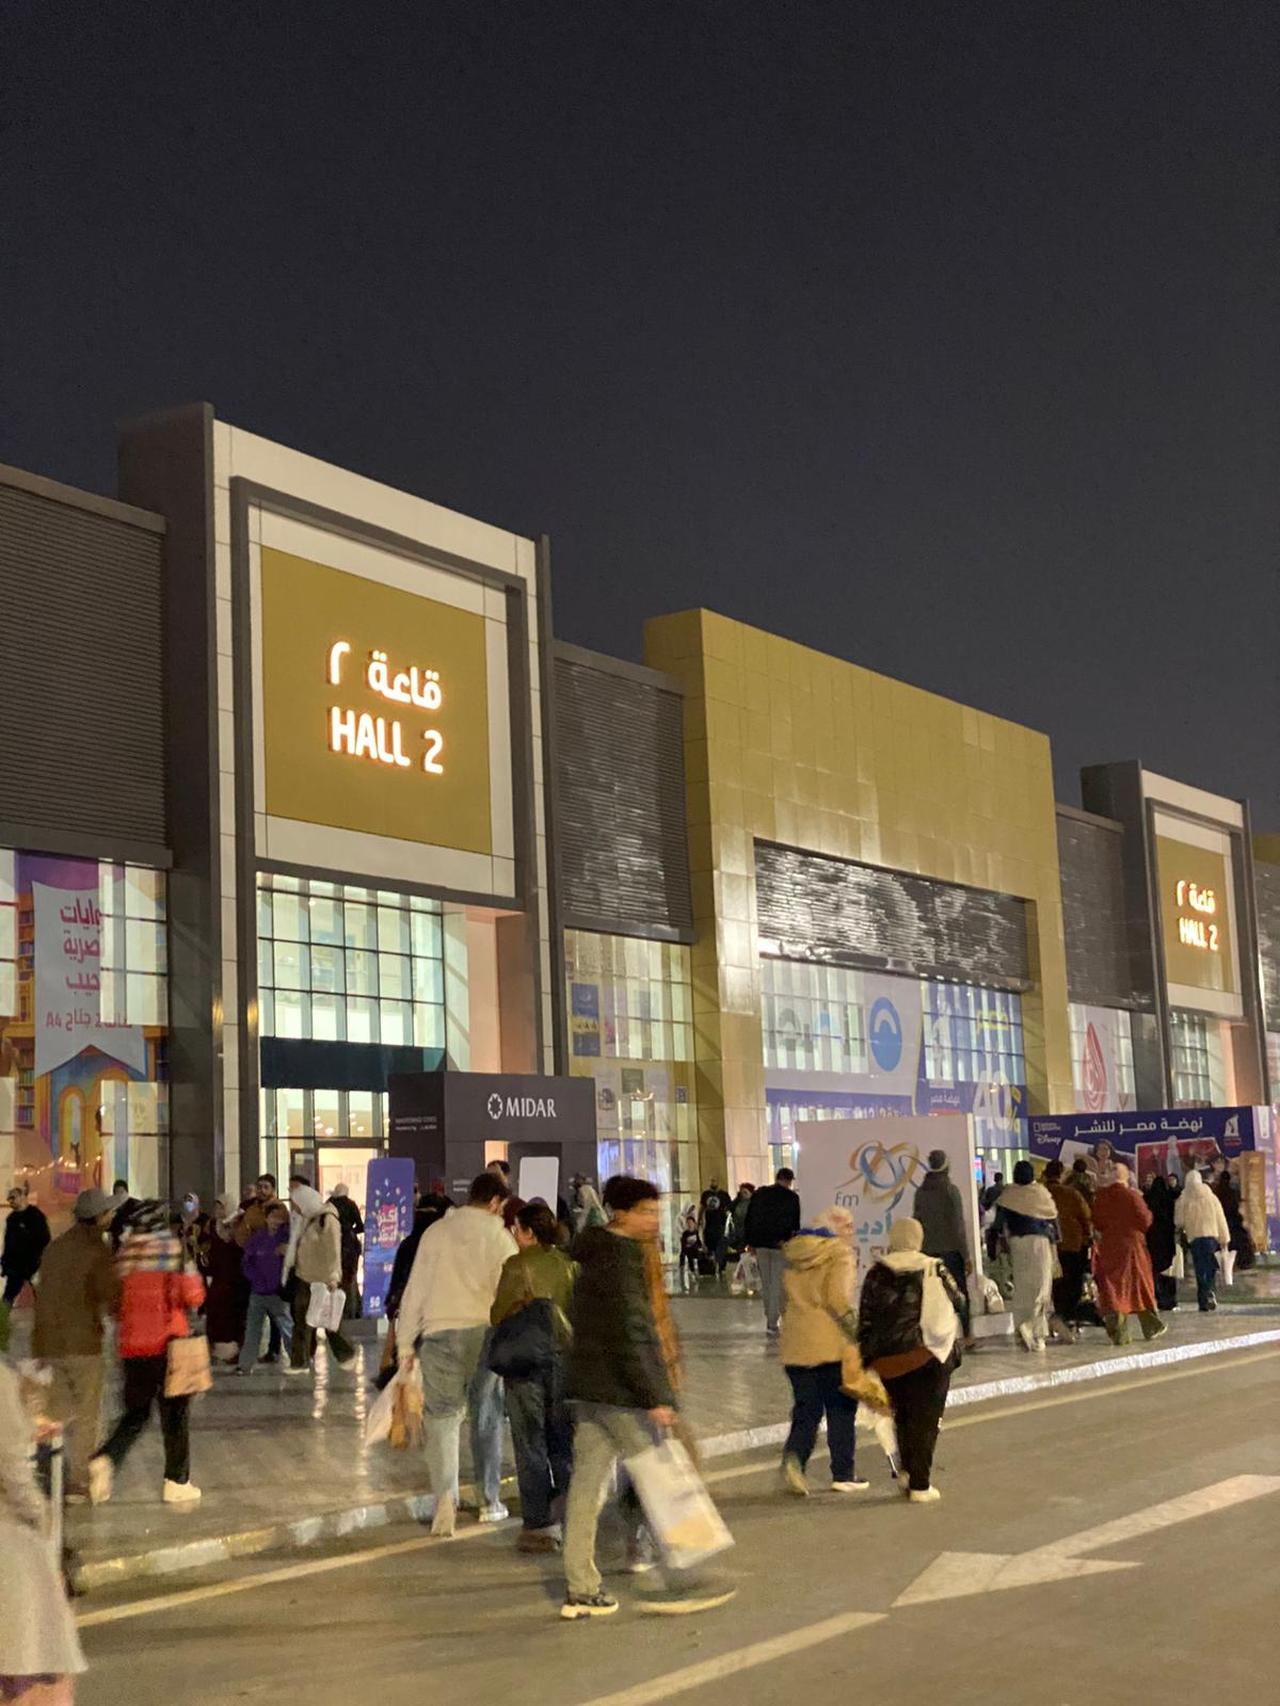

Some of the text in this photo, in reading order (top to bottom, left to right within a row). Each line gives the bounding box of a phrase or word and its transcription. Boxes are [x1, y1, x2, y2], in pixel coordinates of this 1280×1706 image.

[367, 649, 442, 711] قاعة
[331, 705, 444, 775] HALL 2
[59, 898, 104, 934] وايات
[63, 929, 101, 964] صرية
[1179, 917, 1219, 952] HALL 2
[506, 1096, 557, 1118] MIDAR
[1160, 1116, 1204, 1131] نهضة
[1074, 1119, 1116, 1137] للنشر
[1118, 1122, 1157, 1136] مصر
